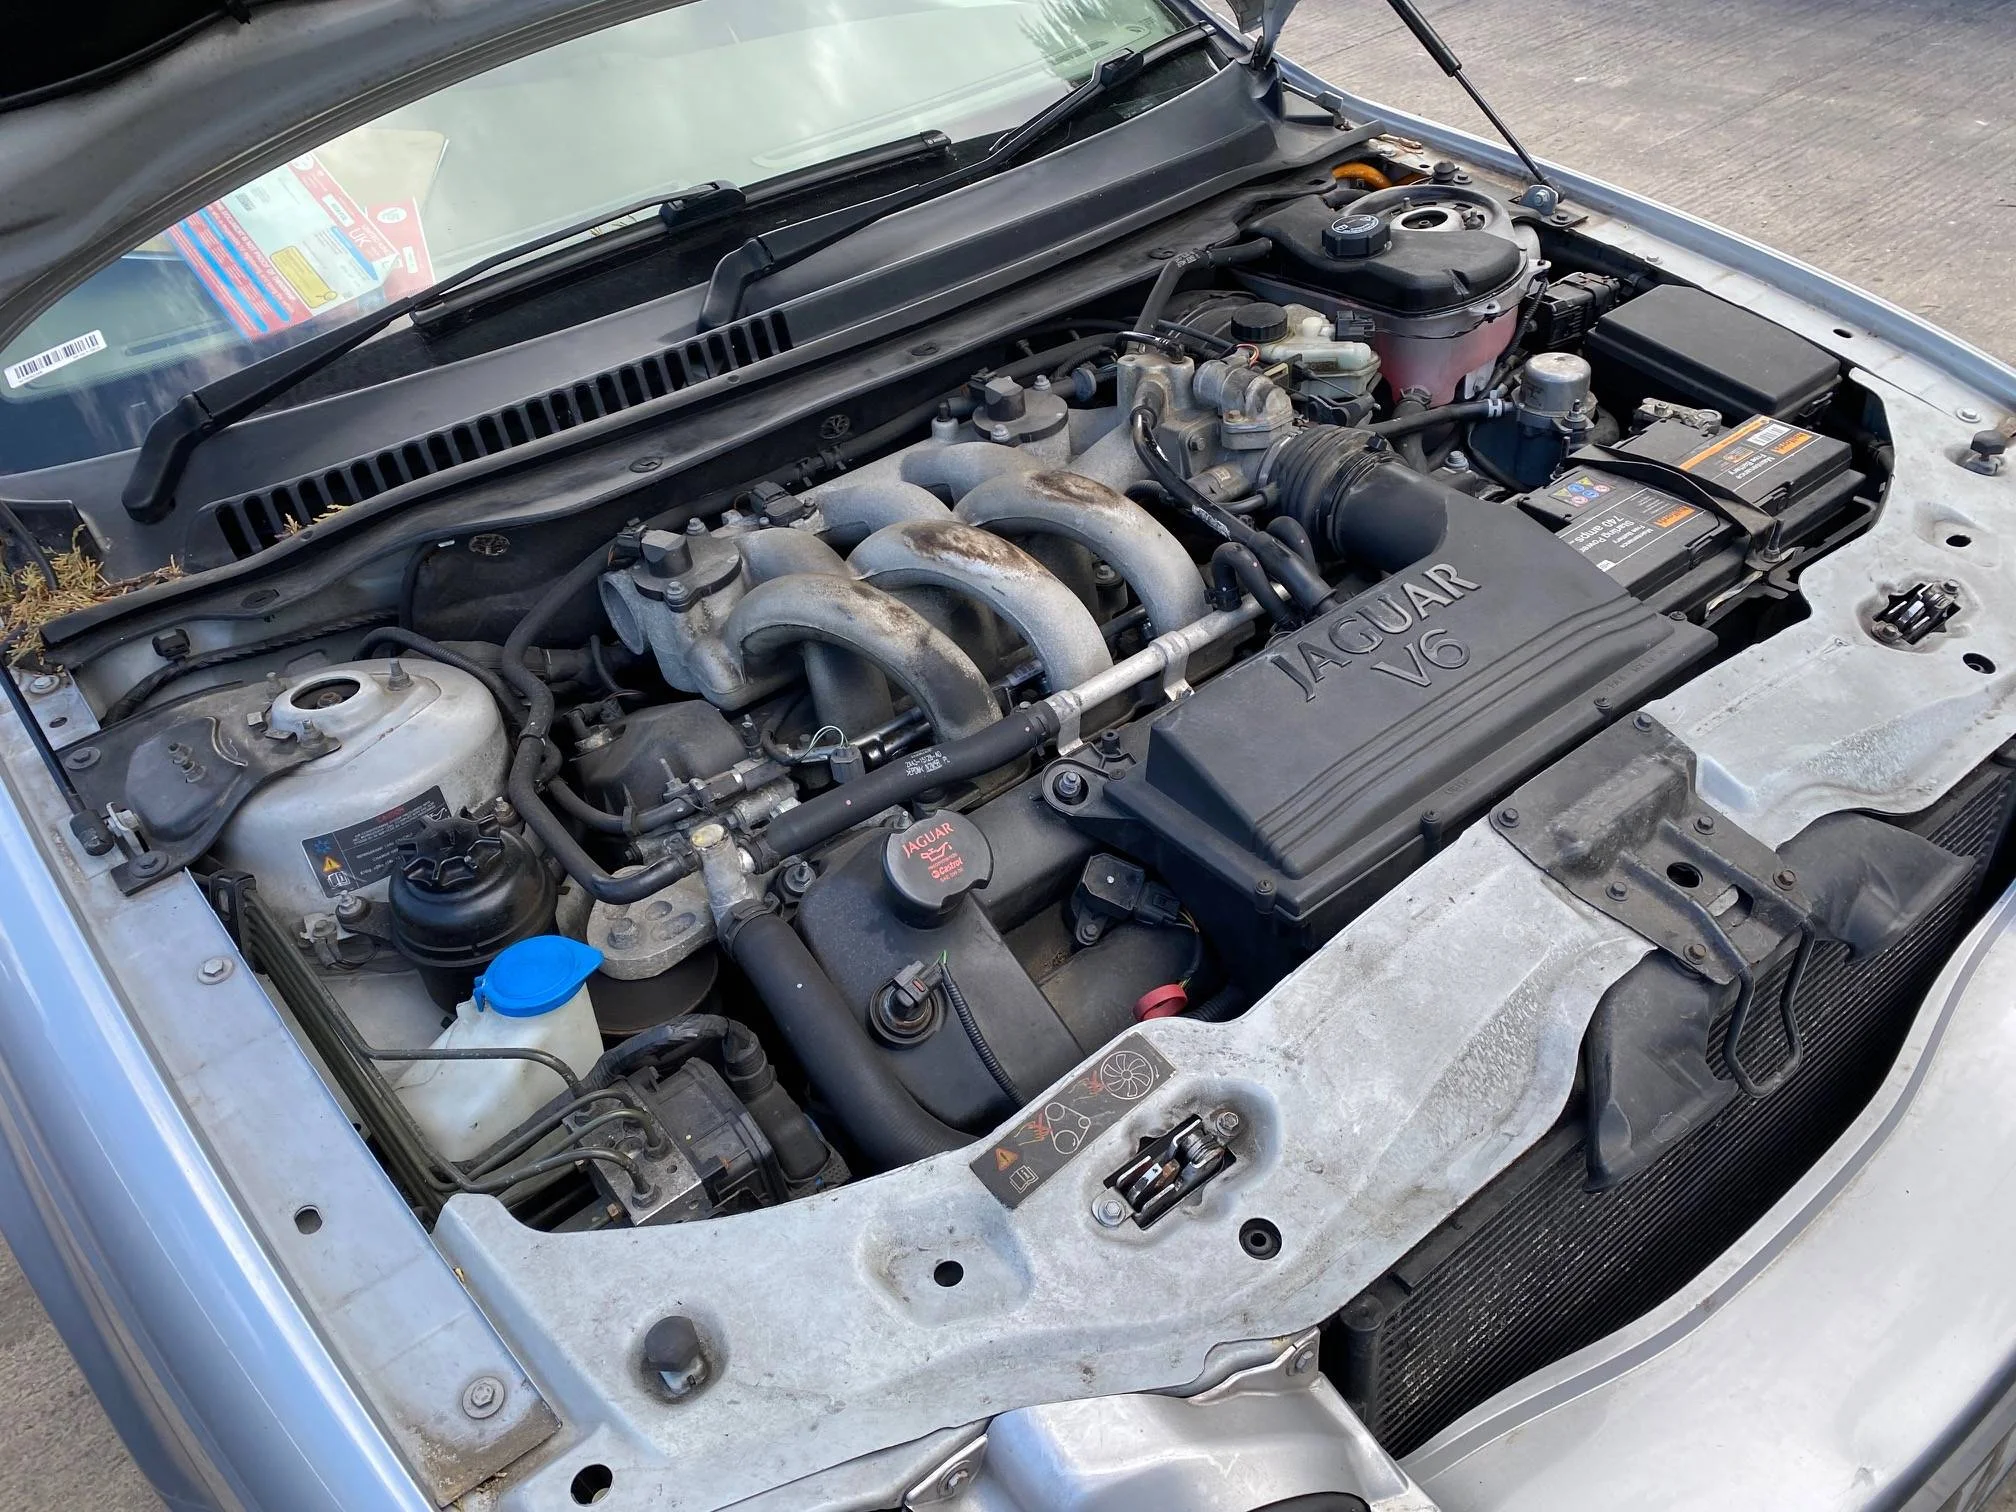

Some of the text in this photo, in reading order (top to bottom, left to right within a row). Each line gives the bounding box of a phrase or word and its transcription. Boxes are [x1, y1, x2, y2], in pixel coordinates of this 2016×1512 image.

[349, 227, 370, 248] UK
[1574, 515, 1624, 543] 740 amps
[1579, 520, 1635, 553] Starting Power
[1271, 563, 1481, 702] JAGUAR
[1370, 628, 1470, 688] V6
[902, 823, 954, 858] JAGUAR
[939, 857, 963, 874] Castrol
